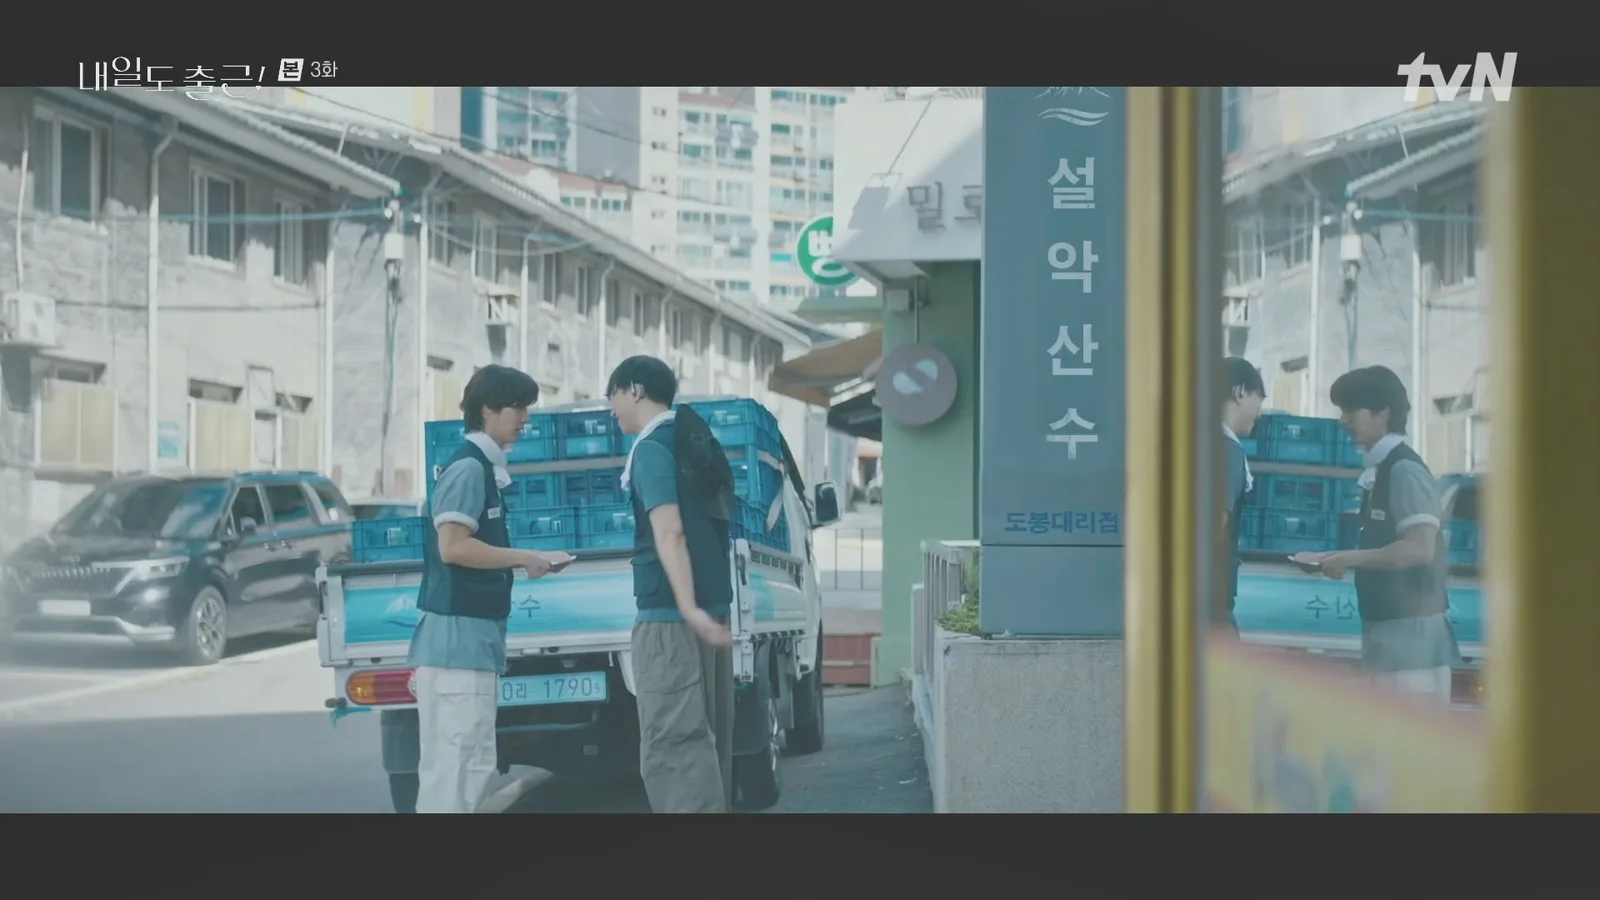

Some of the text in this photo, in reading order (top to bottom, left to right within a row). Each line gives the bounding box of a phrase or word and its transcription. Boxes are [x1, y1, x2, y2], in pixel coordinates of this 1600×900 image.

[1046, 156, 1099, 460] 설악산수
[1004, 510, 1119, 534] 도봉대리점
[542, 677, 592, 699] 1790
